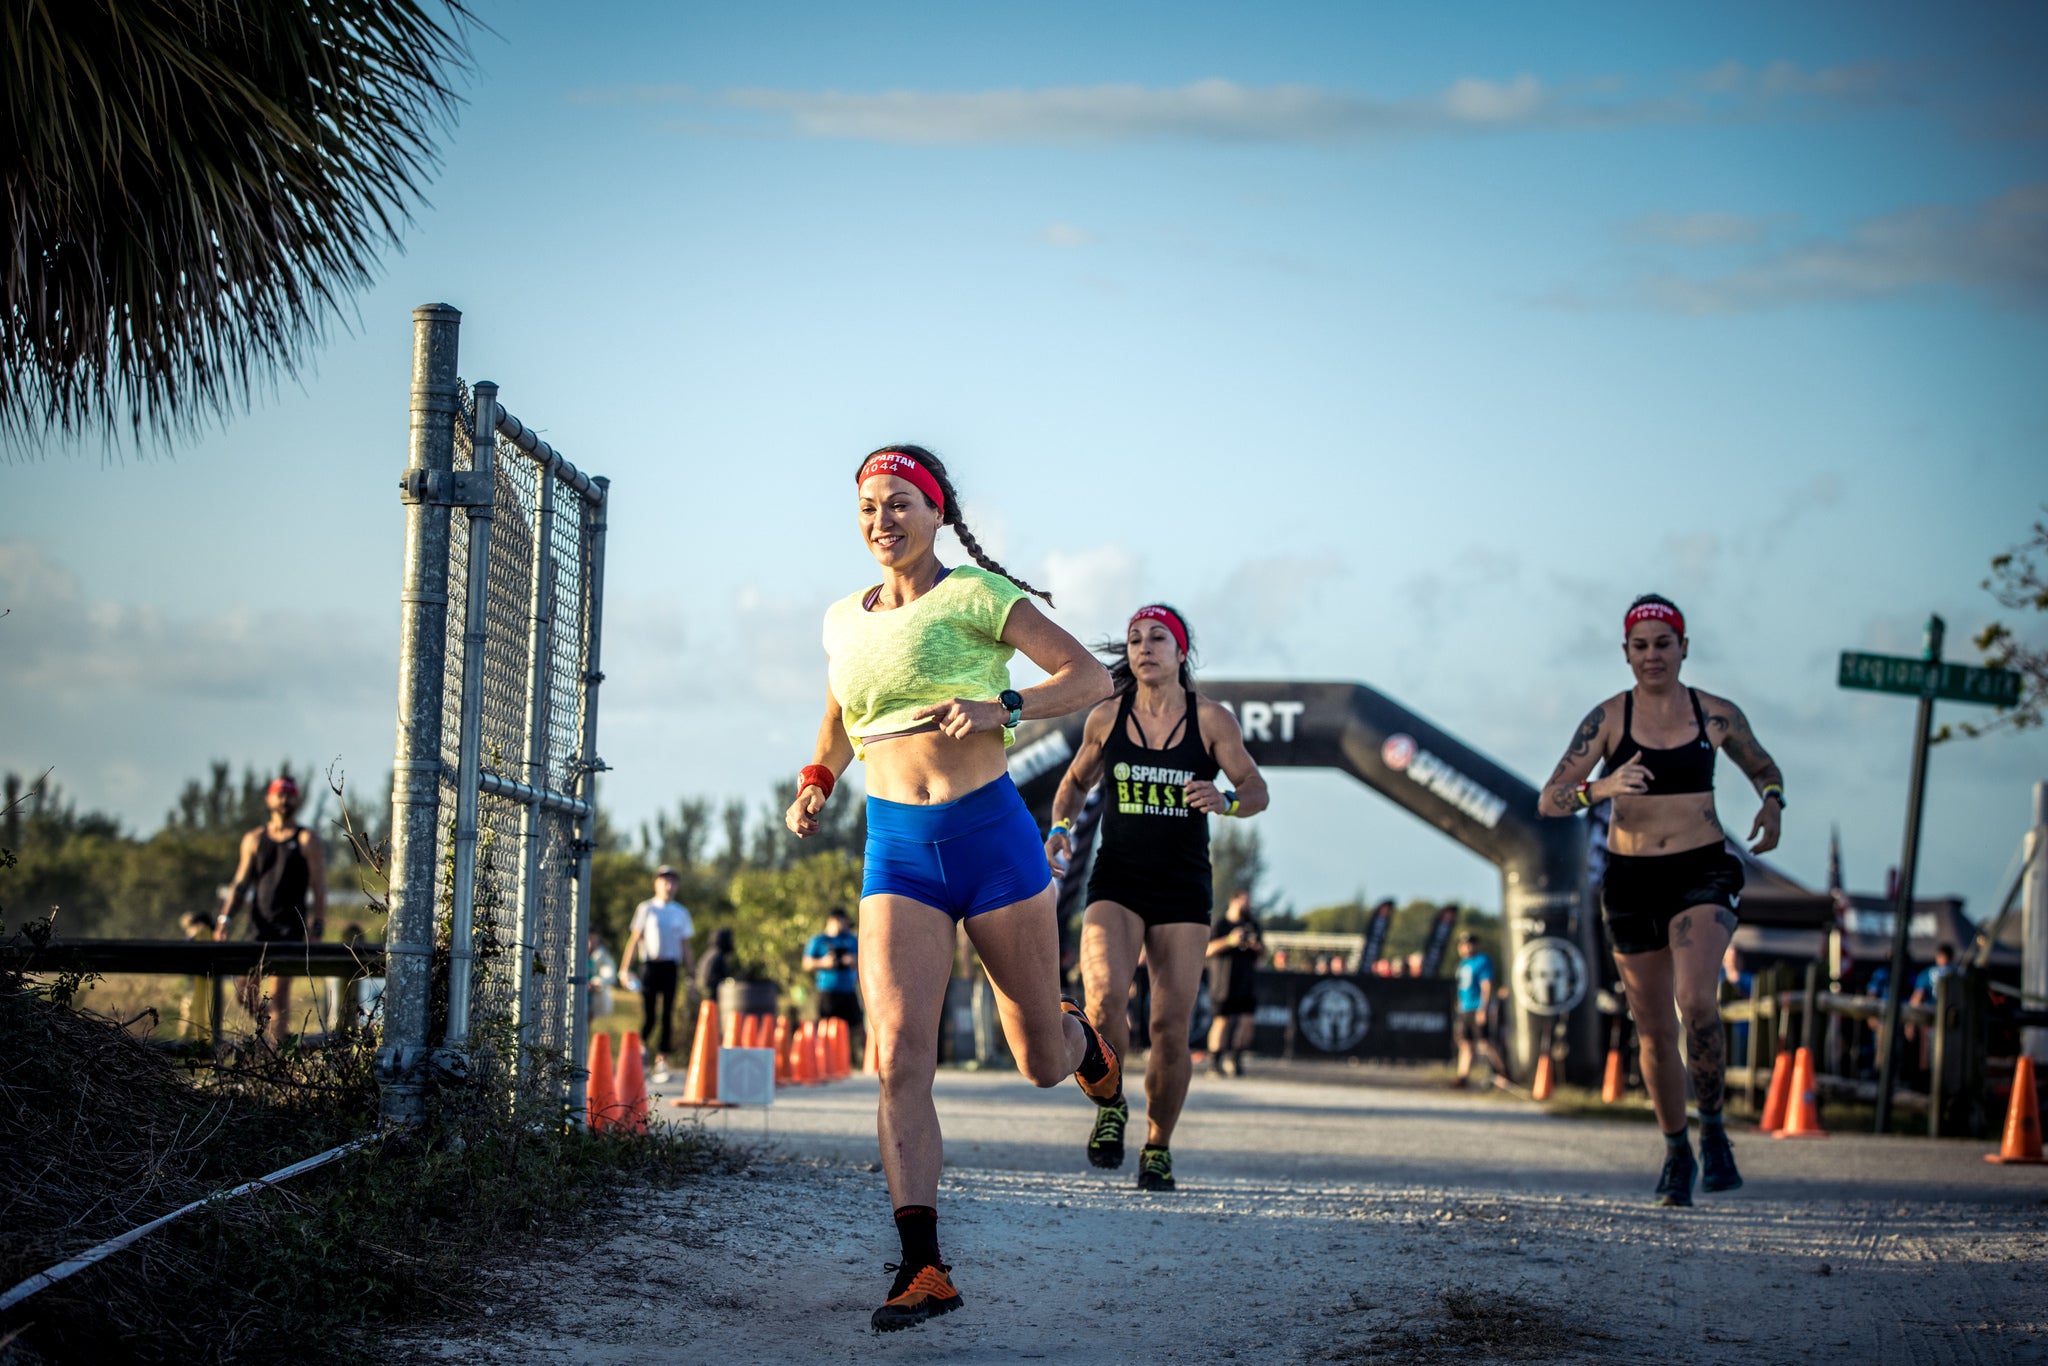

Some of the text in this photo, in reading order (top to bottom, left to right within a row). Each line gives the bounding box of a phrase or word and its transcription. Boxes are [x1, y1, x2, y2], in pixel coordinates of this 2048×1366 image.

[865, 462, 898, 475] 1044
[869, 454, 916, 469] SPARTAN
[1844, 653, 2017, 697] Regional Park
[1131, 764, 1194, 786] SPARTAN
